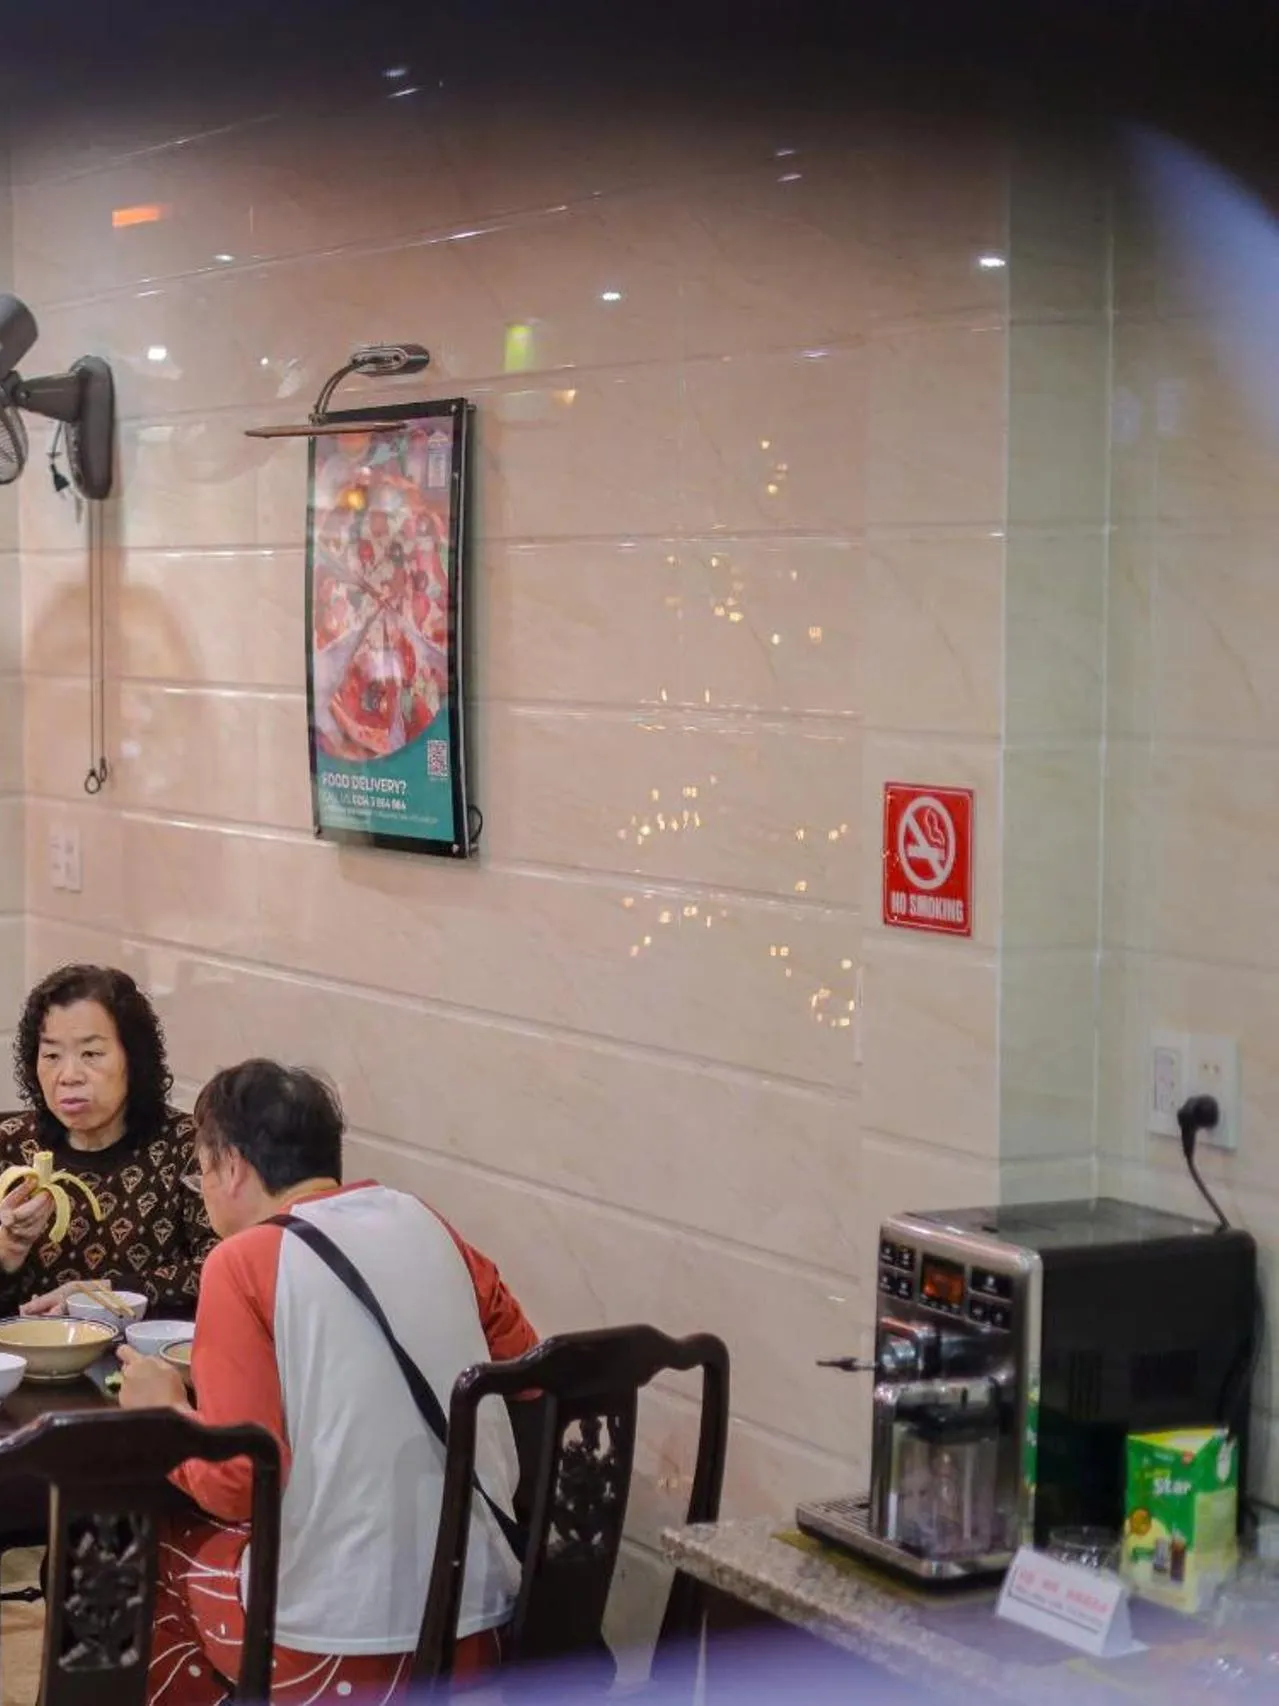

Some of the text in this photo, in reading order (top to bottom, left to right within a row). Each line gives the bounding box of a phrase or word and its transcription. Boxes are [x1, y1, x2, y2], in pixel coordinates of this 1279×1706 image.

[322, 771, 407, 795] FOOD DELIVERY?
[891, 891, 964, 923] NO SMOKING
